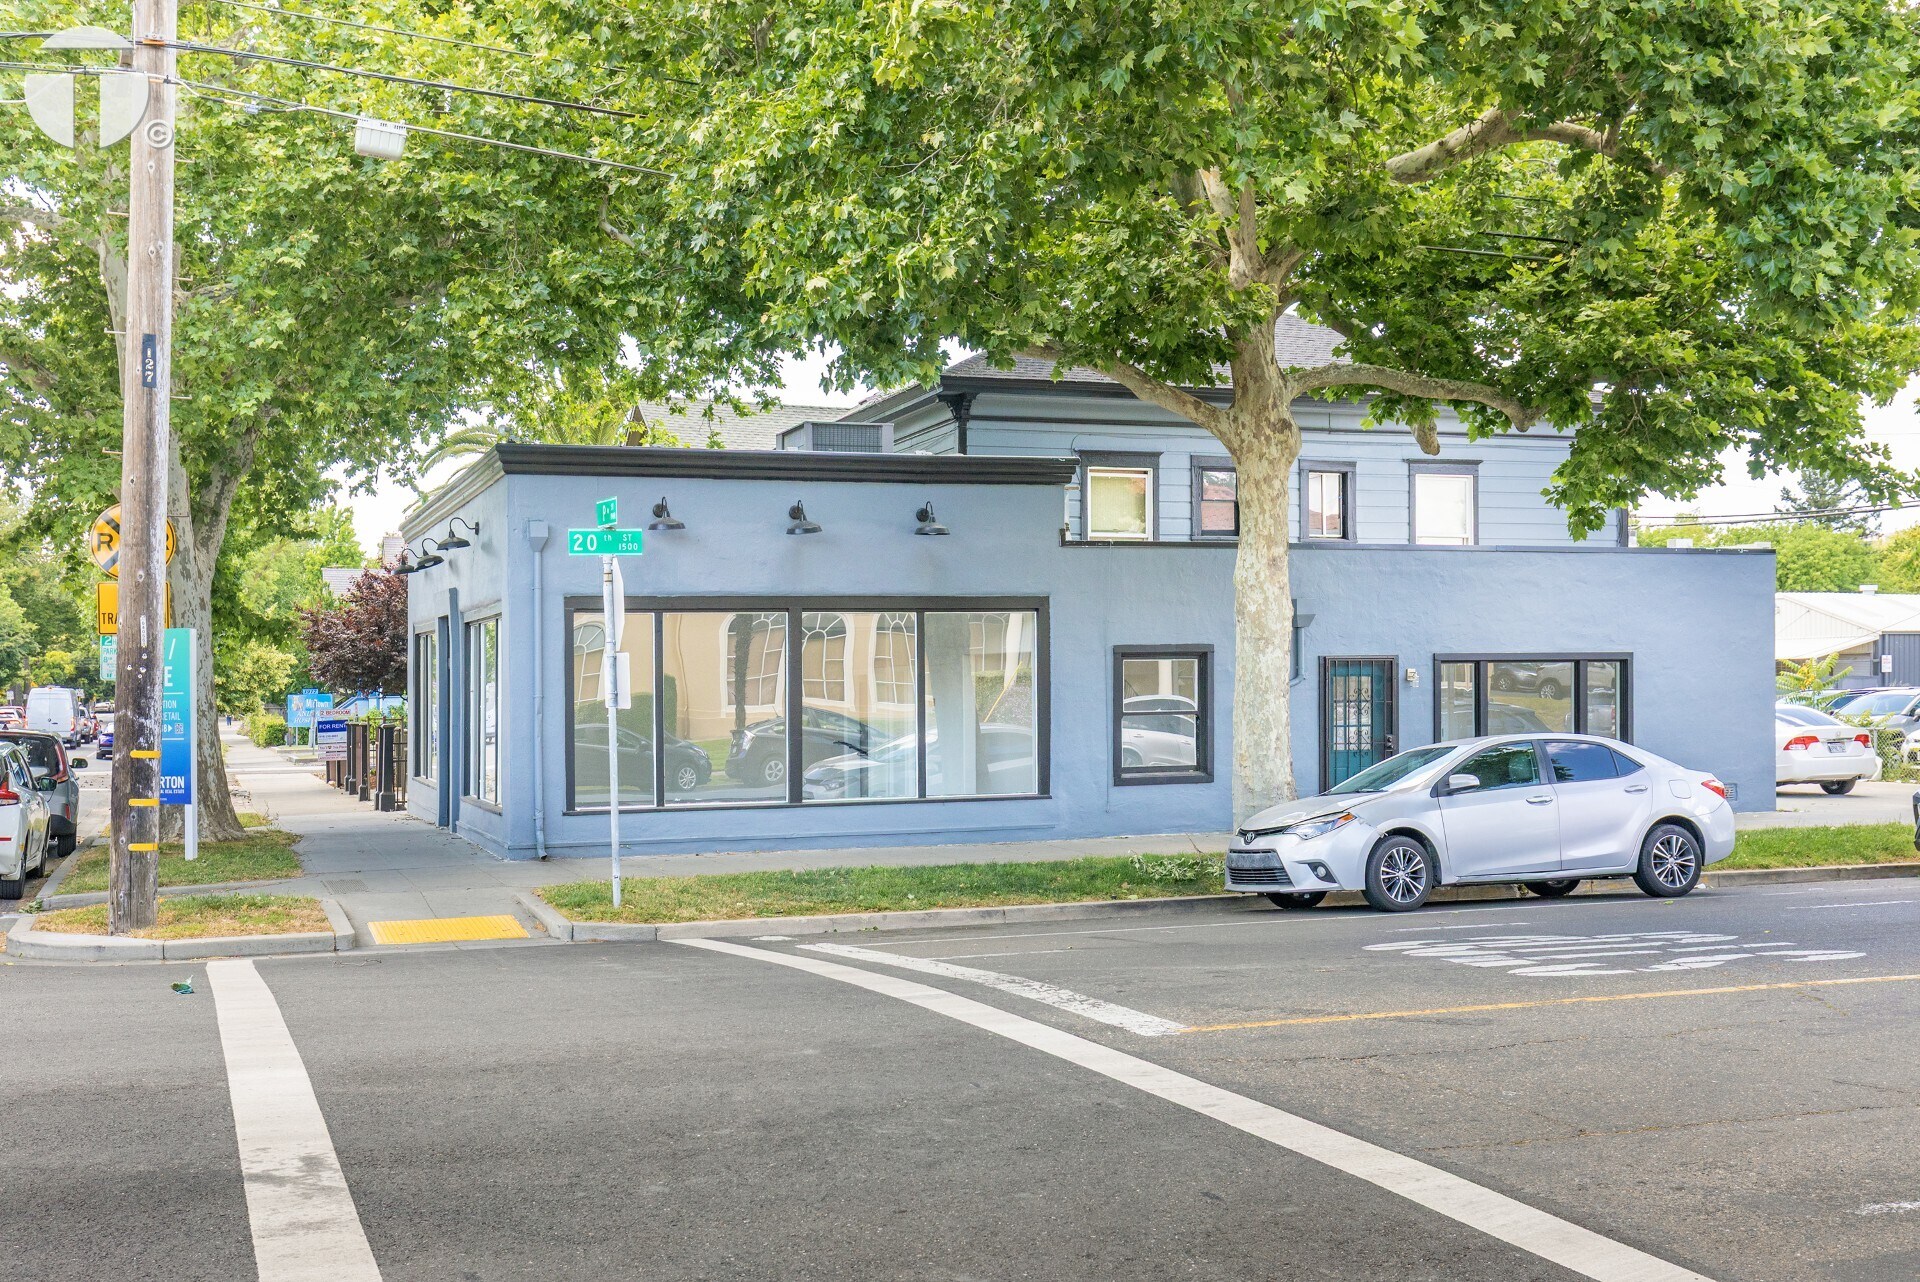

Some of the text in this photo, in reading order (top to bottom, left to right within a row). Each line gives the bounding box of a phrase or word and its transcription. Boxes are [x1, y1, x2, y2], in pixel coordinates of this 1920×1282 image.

[145, 347, 155, 383] 127
[97, 532, 114, 552] R
[573, 533, 633, 551] 20 th ST
[618, 542, 638, 551] 1500
[103, 635, 112, 646] 2
[162, 711, 181, 721] ETAIL
